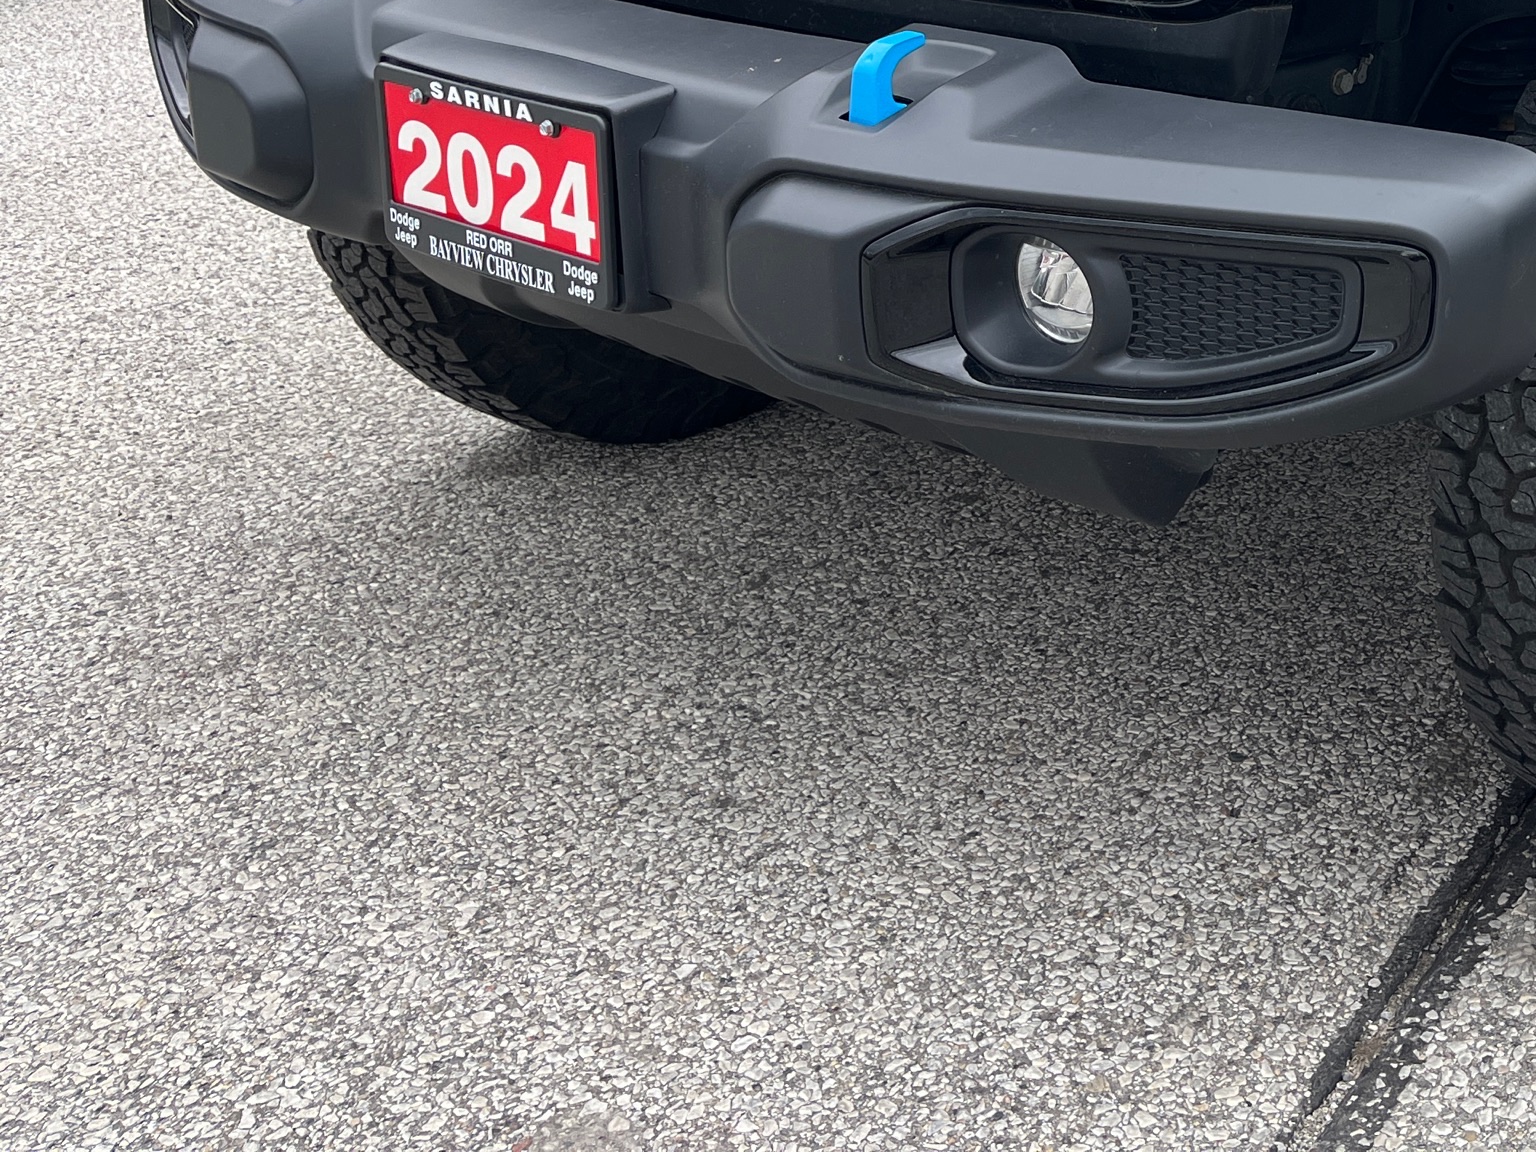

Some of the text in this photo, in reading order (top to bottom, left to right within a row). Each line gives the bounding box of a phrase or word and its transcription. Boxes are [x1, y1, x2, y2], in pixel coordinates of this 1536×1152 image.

[429, 81, 533, 123] SARNIA
[397, 119, 597, 257] 2024
[389, 207, 421, 231] Dodge
[394, 226, 418, 250] Jeep
[466, 229, 513, 258] RED ORR
[428, 234, 556, 294] BAYVIEW CHRYSLER
[563, 260, 598, 285] Dodge
[567, 280, 595, 304] Jeep
